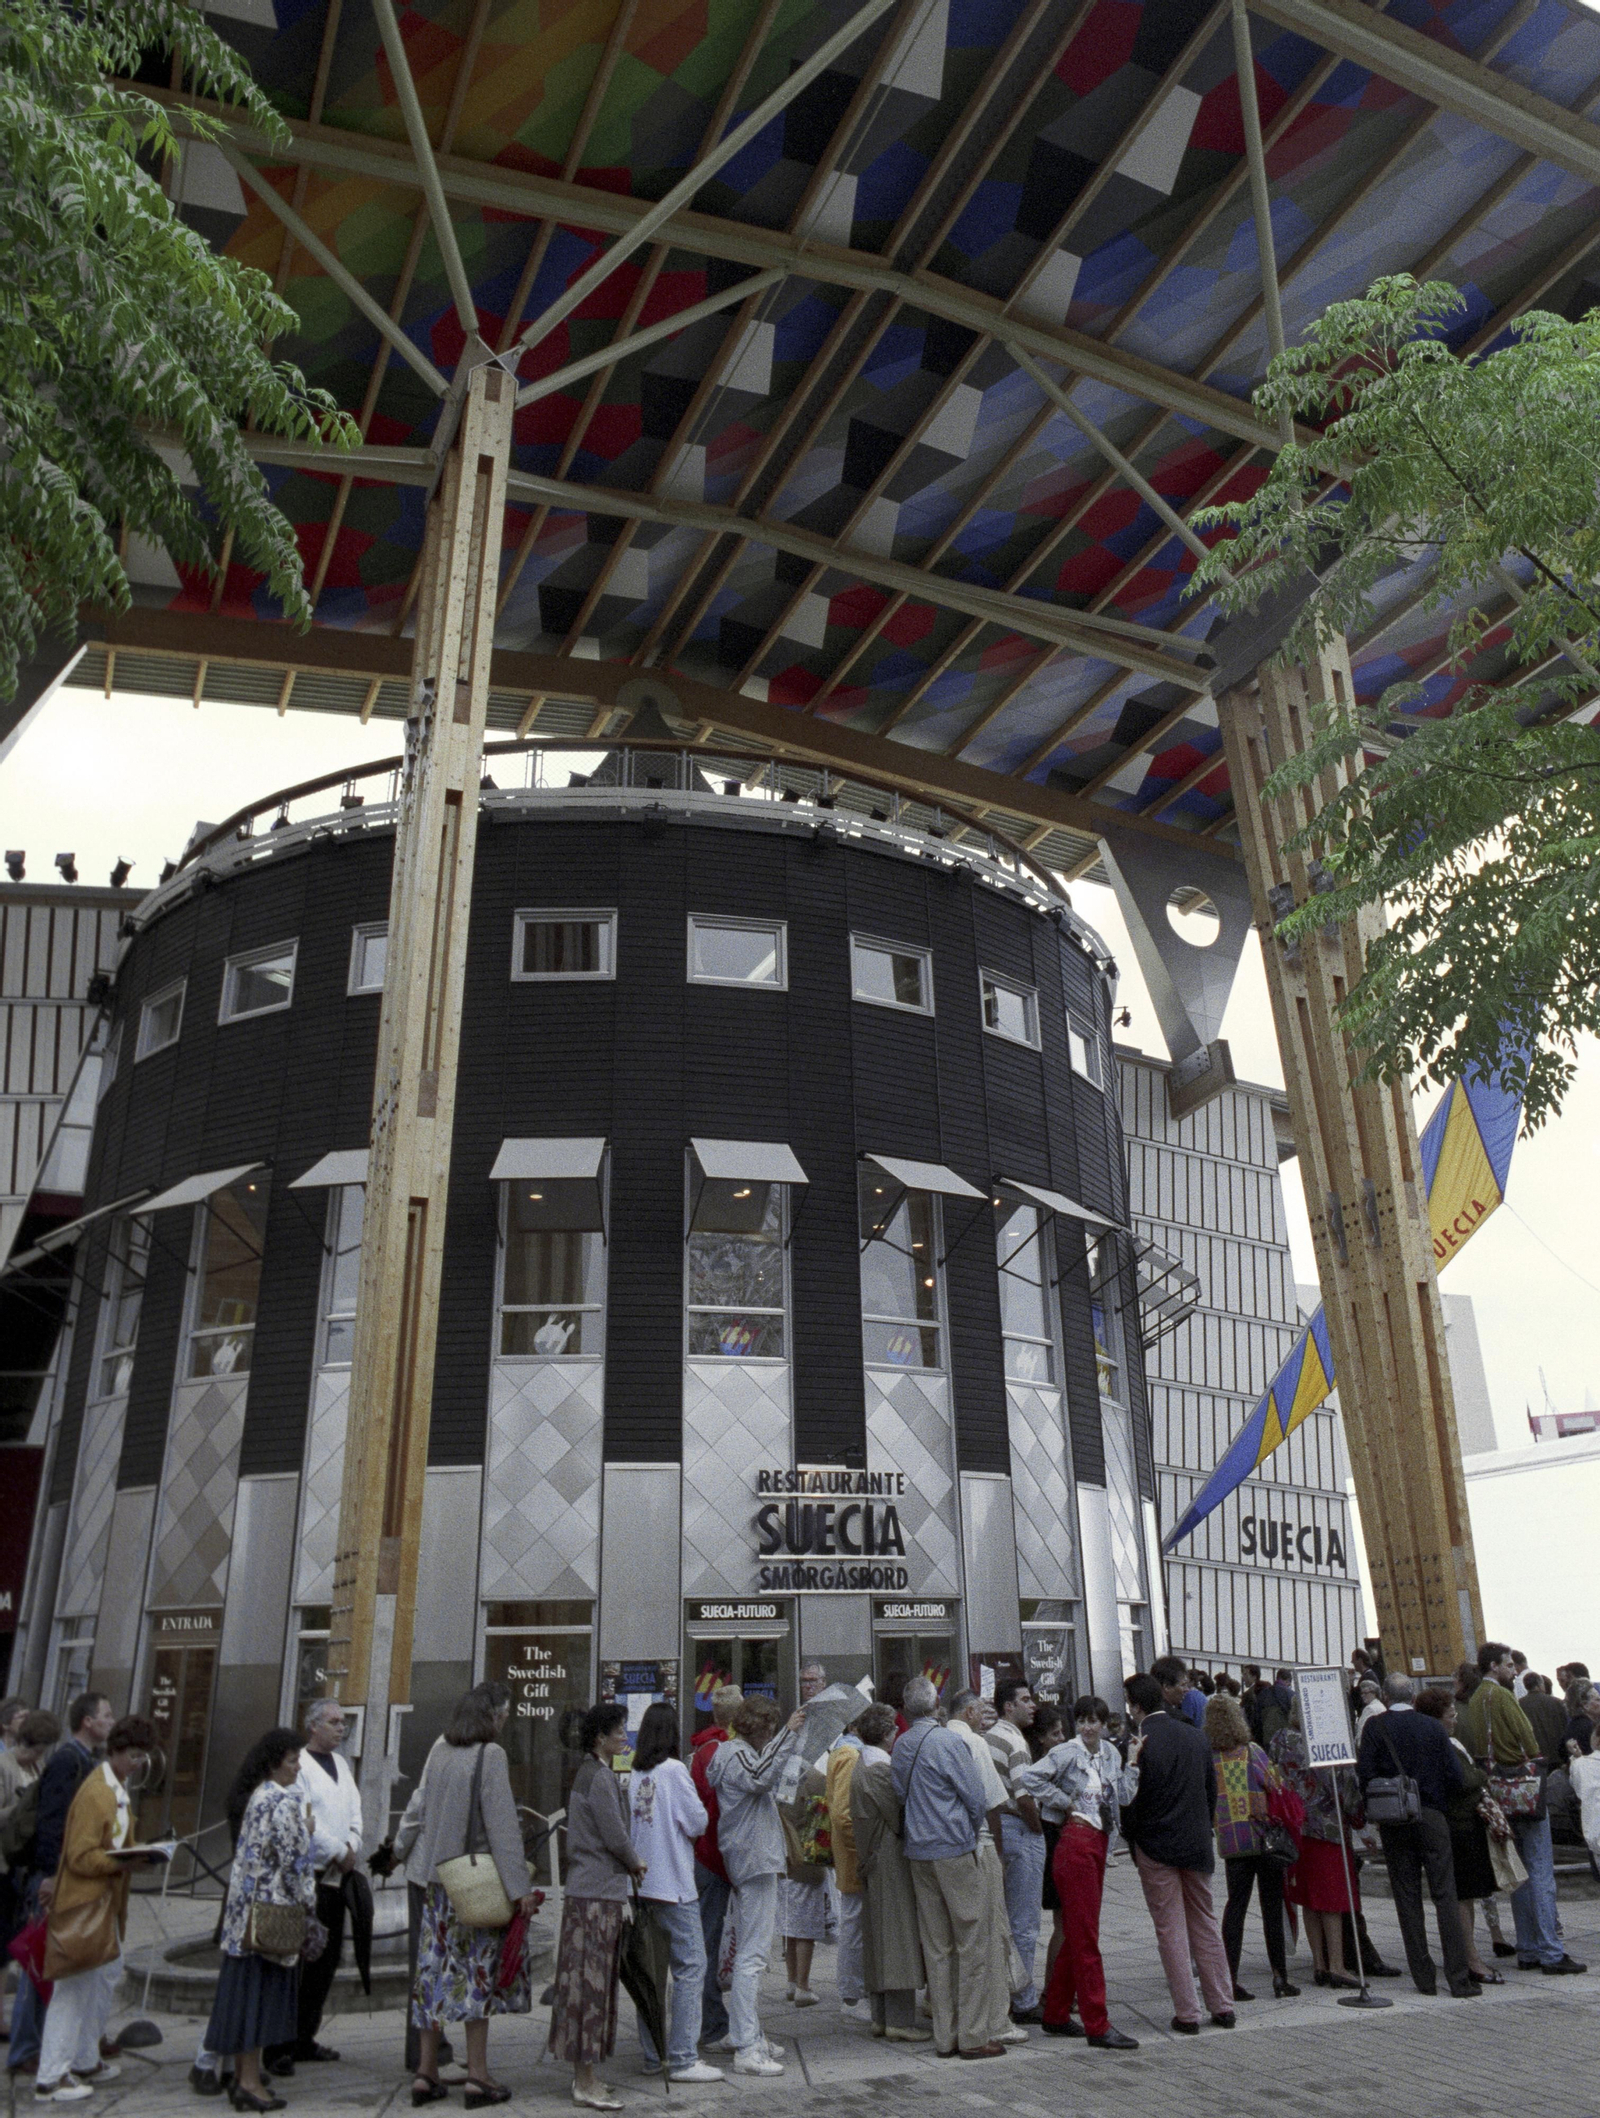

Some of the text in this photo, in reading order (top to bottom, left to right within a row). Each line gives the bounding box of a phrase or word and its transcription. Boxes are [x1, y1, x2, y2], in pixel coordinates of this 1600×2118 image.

[1433, 1199, 1487, 1258] UECIA
[758, 1469, 905, 1495] RESTAURANTE
[757, 1503, 906, 1557] SUECIA
[1241, 1515, 1346, 1569] SUECIA
[700, 1604, 777, 1619] SUECIA-FUTURO
[883, 1603, 946, 1618] SUECIA-FUTURO
[162, 1616, 213, 1631] ENTRADA
[523, 1646, 552, 1661] The
[1037, 1640, 1054, 1652] The
[1030, 1656, 1063, 1669] Swedish
[507, 1664, 567, 1680] Swedish
[523, 1683, 550, 1699] Gift
[1038, 1690, 1060, 1706] Shop
[516, 1702, 555, 1721] Shop
[1311, 1743, 1349, 1762] SUECIA
